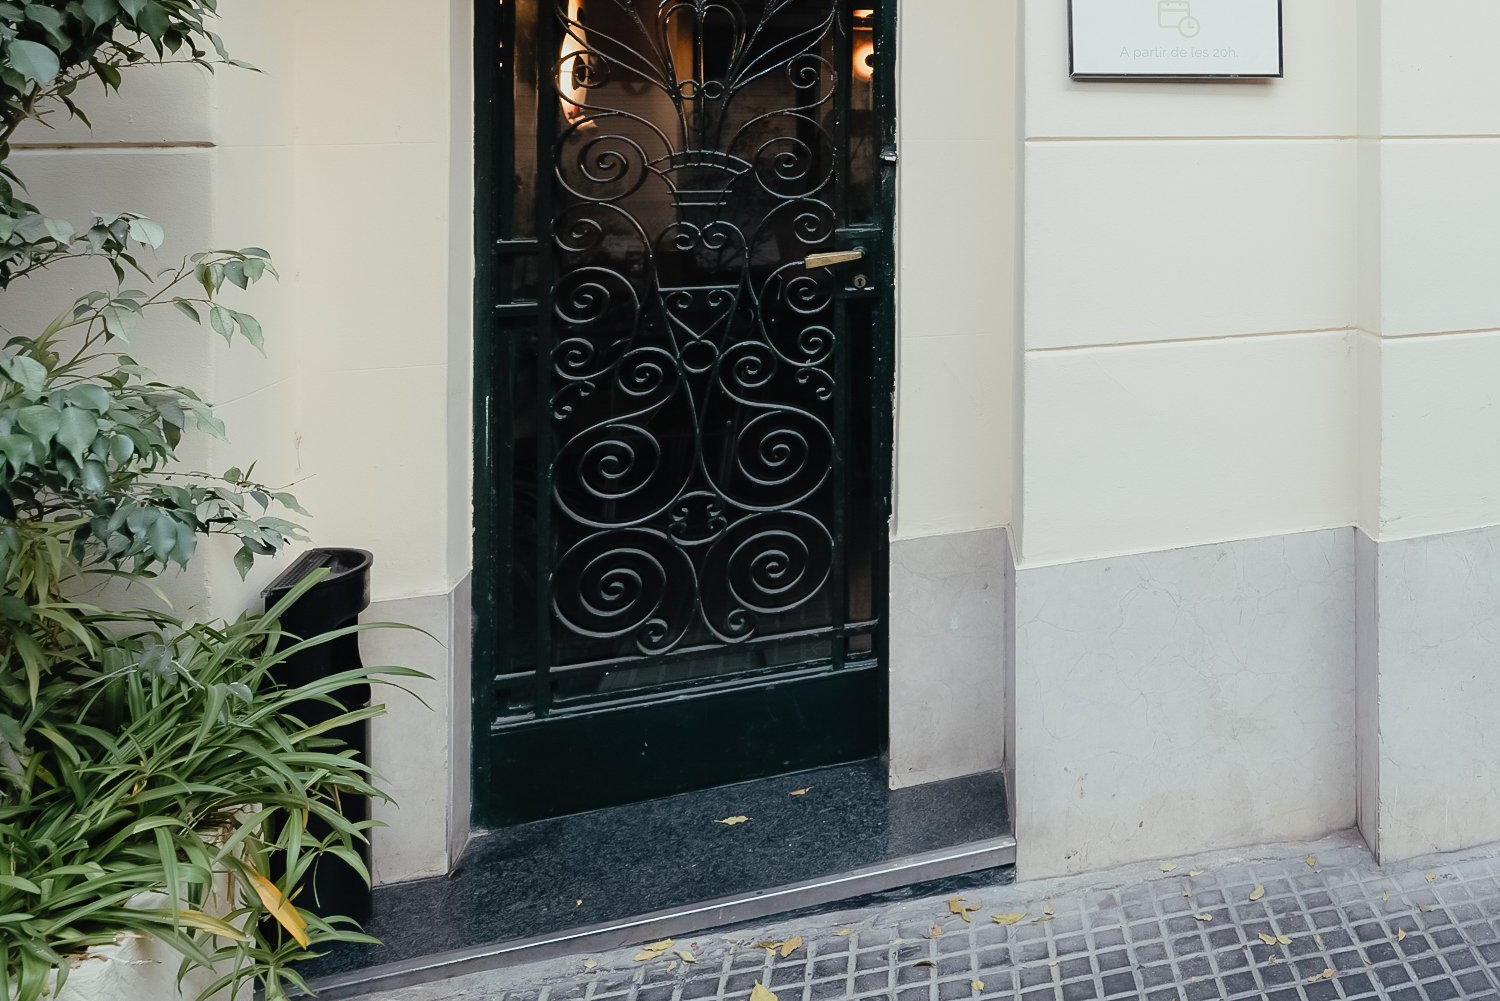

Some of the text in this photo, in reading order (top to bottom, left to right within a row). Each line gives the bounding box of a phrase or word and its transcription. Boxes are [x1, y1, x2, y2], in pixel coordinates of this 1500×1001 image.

[1119, 47, 1239, 61] A partir de les 20h.
